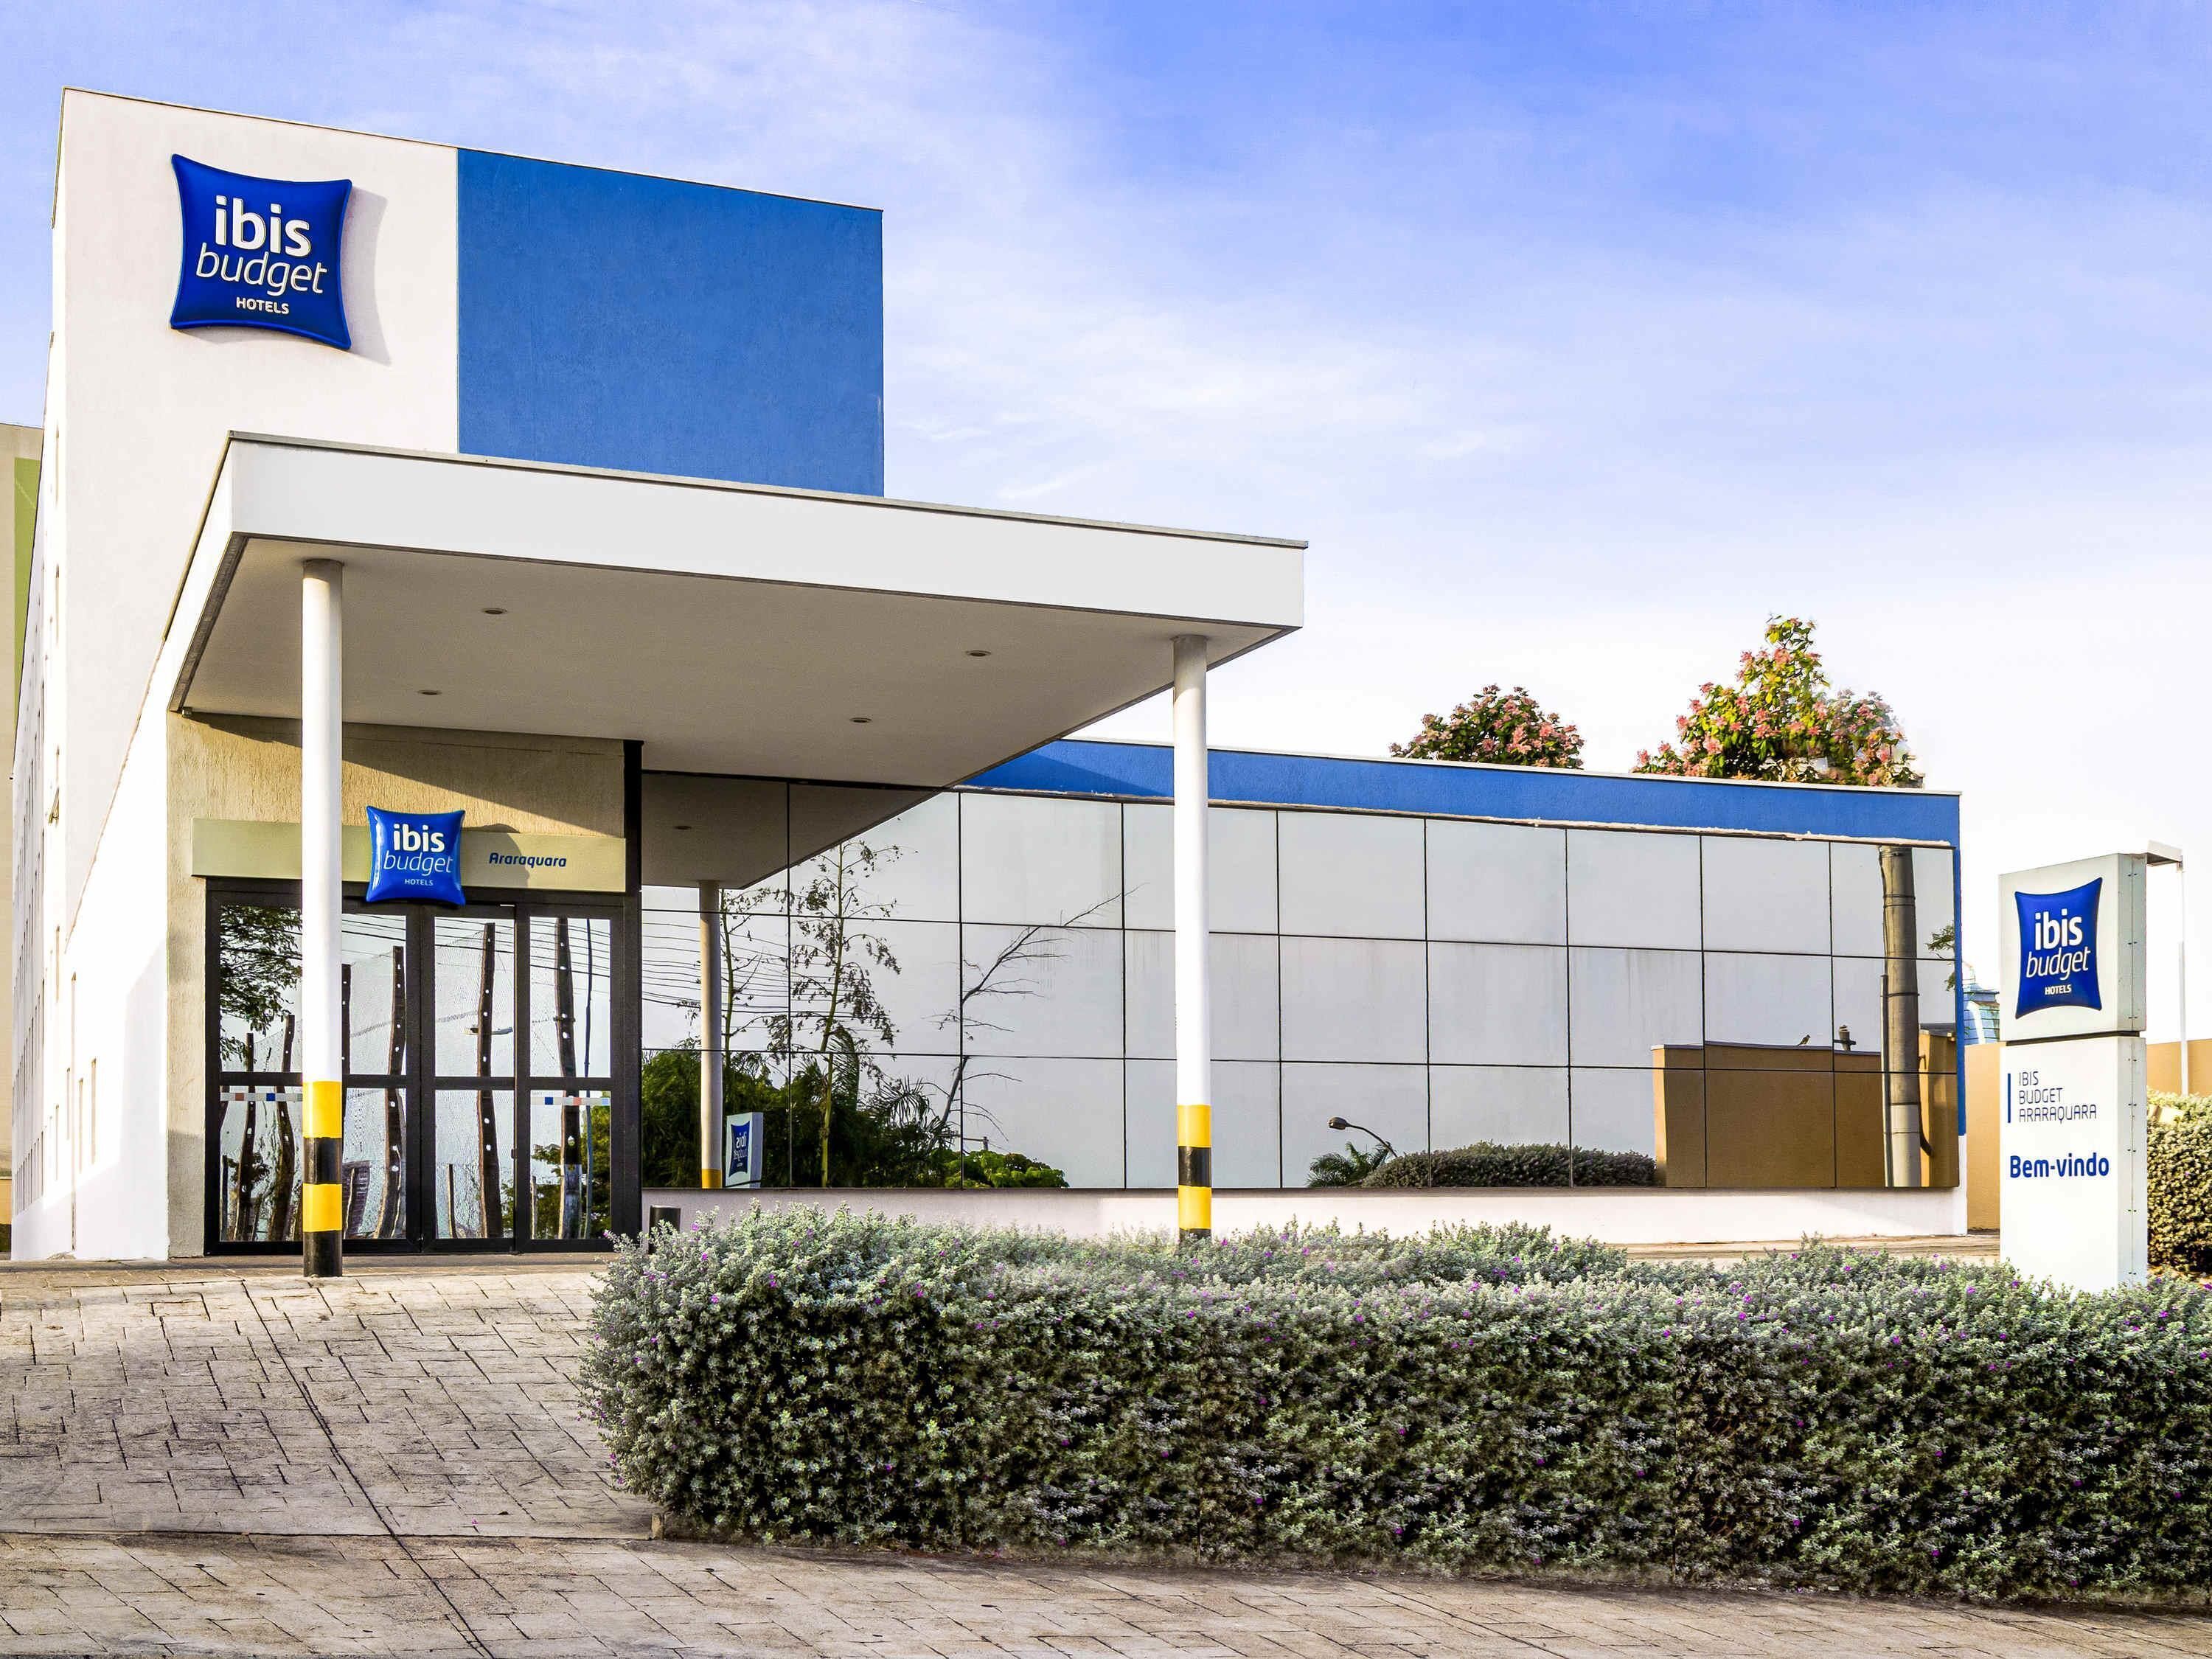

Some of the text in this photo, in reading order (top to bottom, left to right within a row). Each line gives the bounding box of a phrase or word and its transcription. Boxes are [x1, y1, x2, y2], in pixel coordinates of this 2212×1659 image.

[215, 195, 311, 257] ibis
[195, 242, 327, 296] budget
[235, 296, 290, 315] HOTELS
[393, 823, 445, 852] ibis
[383, 849, 453, 876] budget
[488, 852, 567, 869] Araraquara
[404, 878, 434, 886] HOTELS
[2034, 908, 2083, 950] ibis
[2025, 946, 2091, 980] budget
[2044, 984, 2072, 995] HOTELS
[2019, 1071, 2039, 1086] IBIS
[2019, 1088, 2063, 1105] BUDGET
[2019, 1104, 2097, 1124] ARARAQUARA
[2009, 1152, 2110, 1178] Bem-vindo
